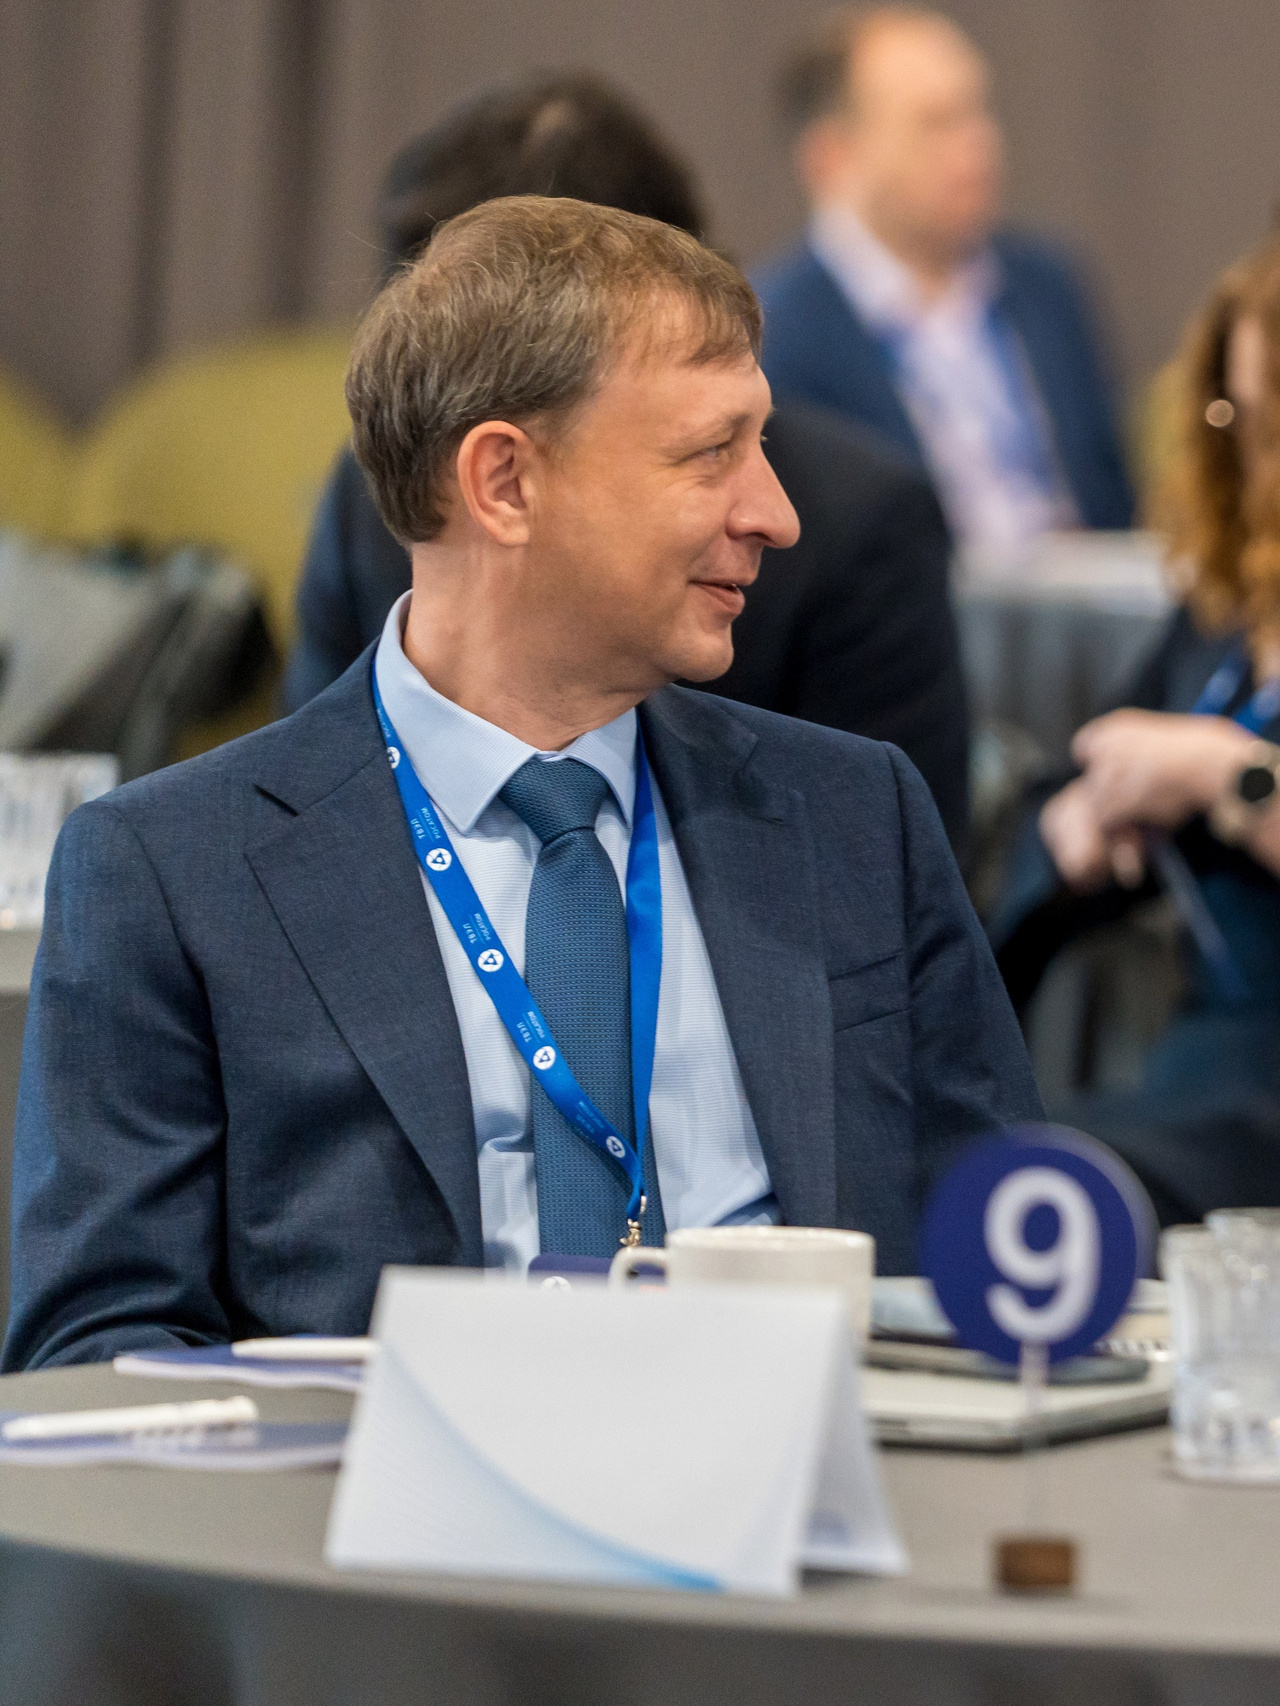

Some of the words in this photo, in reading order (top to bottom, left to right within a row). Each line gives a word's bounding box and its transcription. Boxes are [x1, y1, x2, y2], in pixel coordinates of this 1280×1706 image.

[410, 818, 426, 839] ТВЭЛ
[421, 807, 441, 839] РОСАТОМ
[462, 923, 477, 944] ТВЭЛ
[474, 913, 491, 940] РОСАТОМ
[516, 1021, 531, 1043] ТВЭЛ
[983, 1165, 1101, 1345] 9
